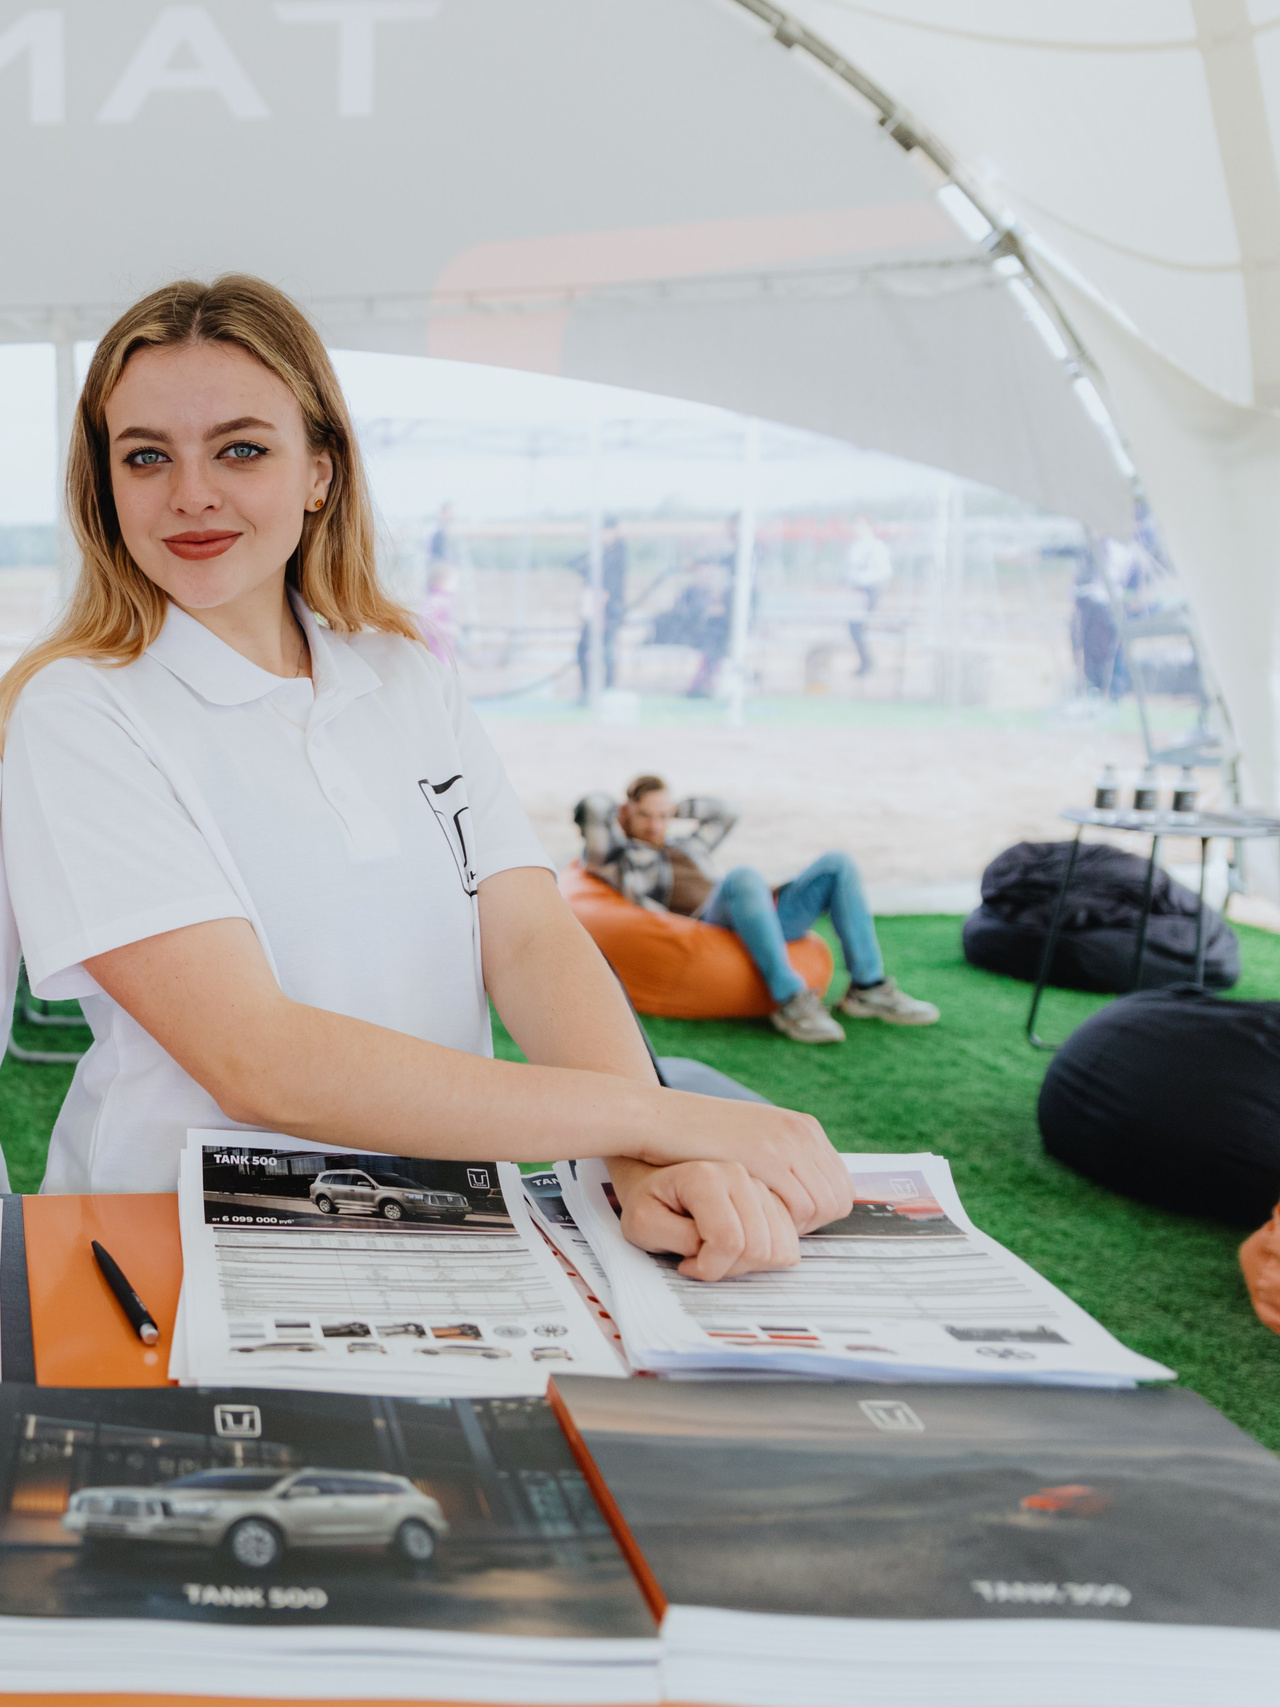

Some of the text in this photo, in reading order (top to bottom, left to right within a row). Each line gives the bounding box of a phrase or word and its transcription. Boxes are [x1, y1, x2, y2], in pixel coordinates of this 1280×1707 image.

[213, 1153, 278, 1167] TANK 500
[221, 1215, 230, 1223] 6
[231, 1215, 254, 1223] 099
[255, 1216, 278, 1224] 000
[183, 1582, 266, 1609] TANK
[971, 1579, 1065, 1604] TANK
